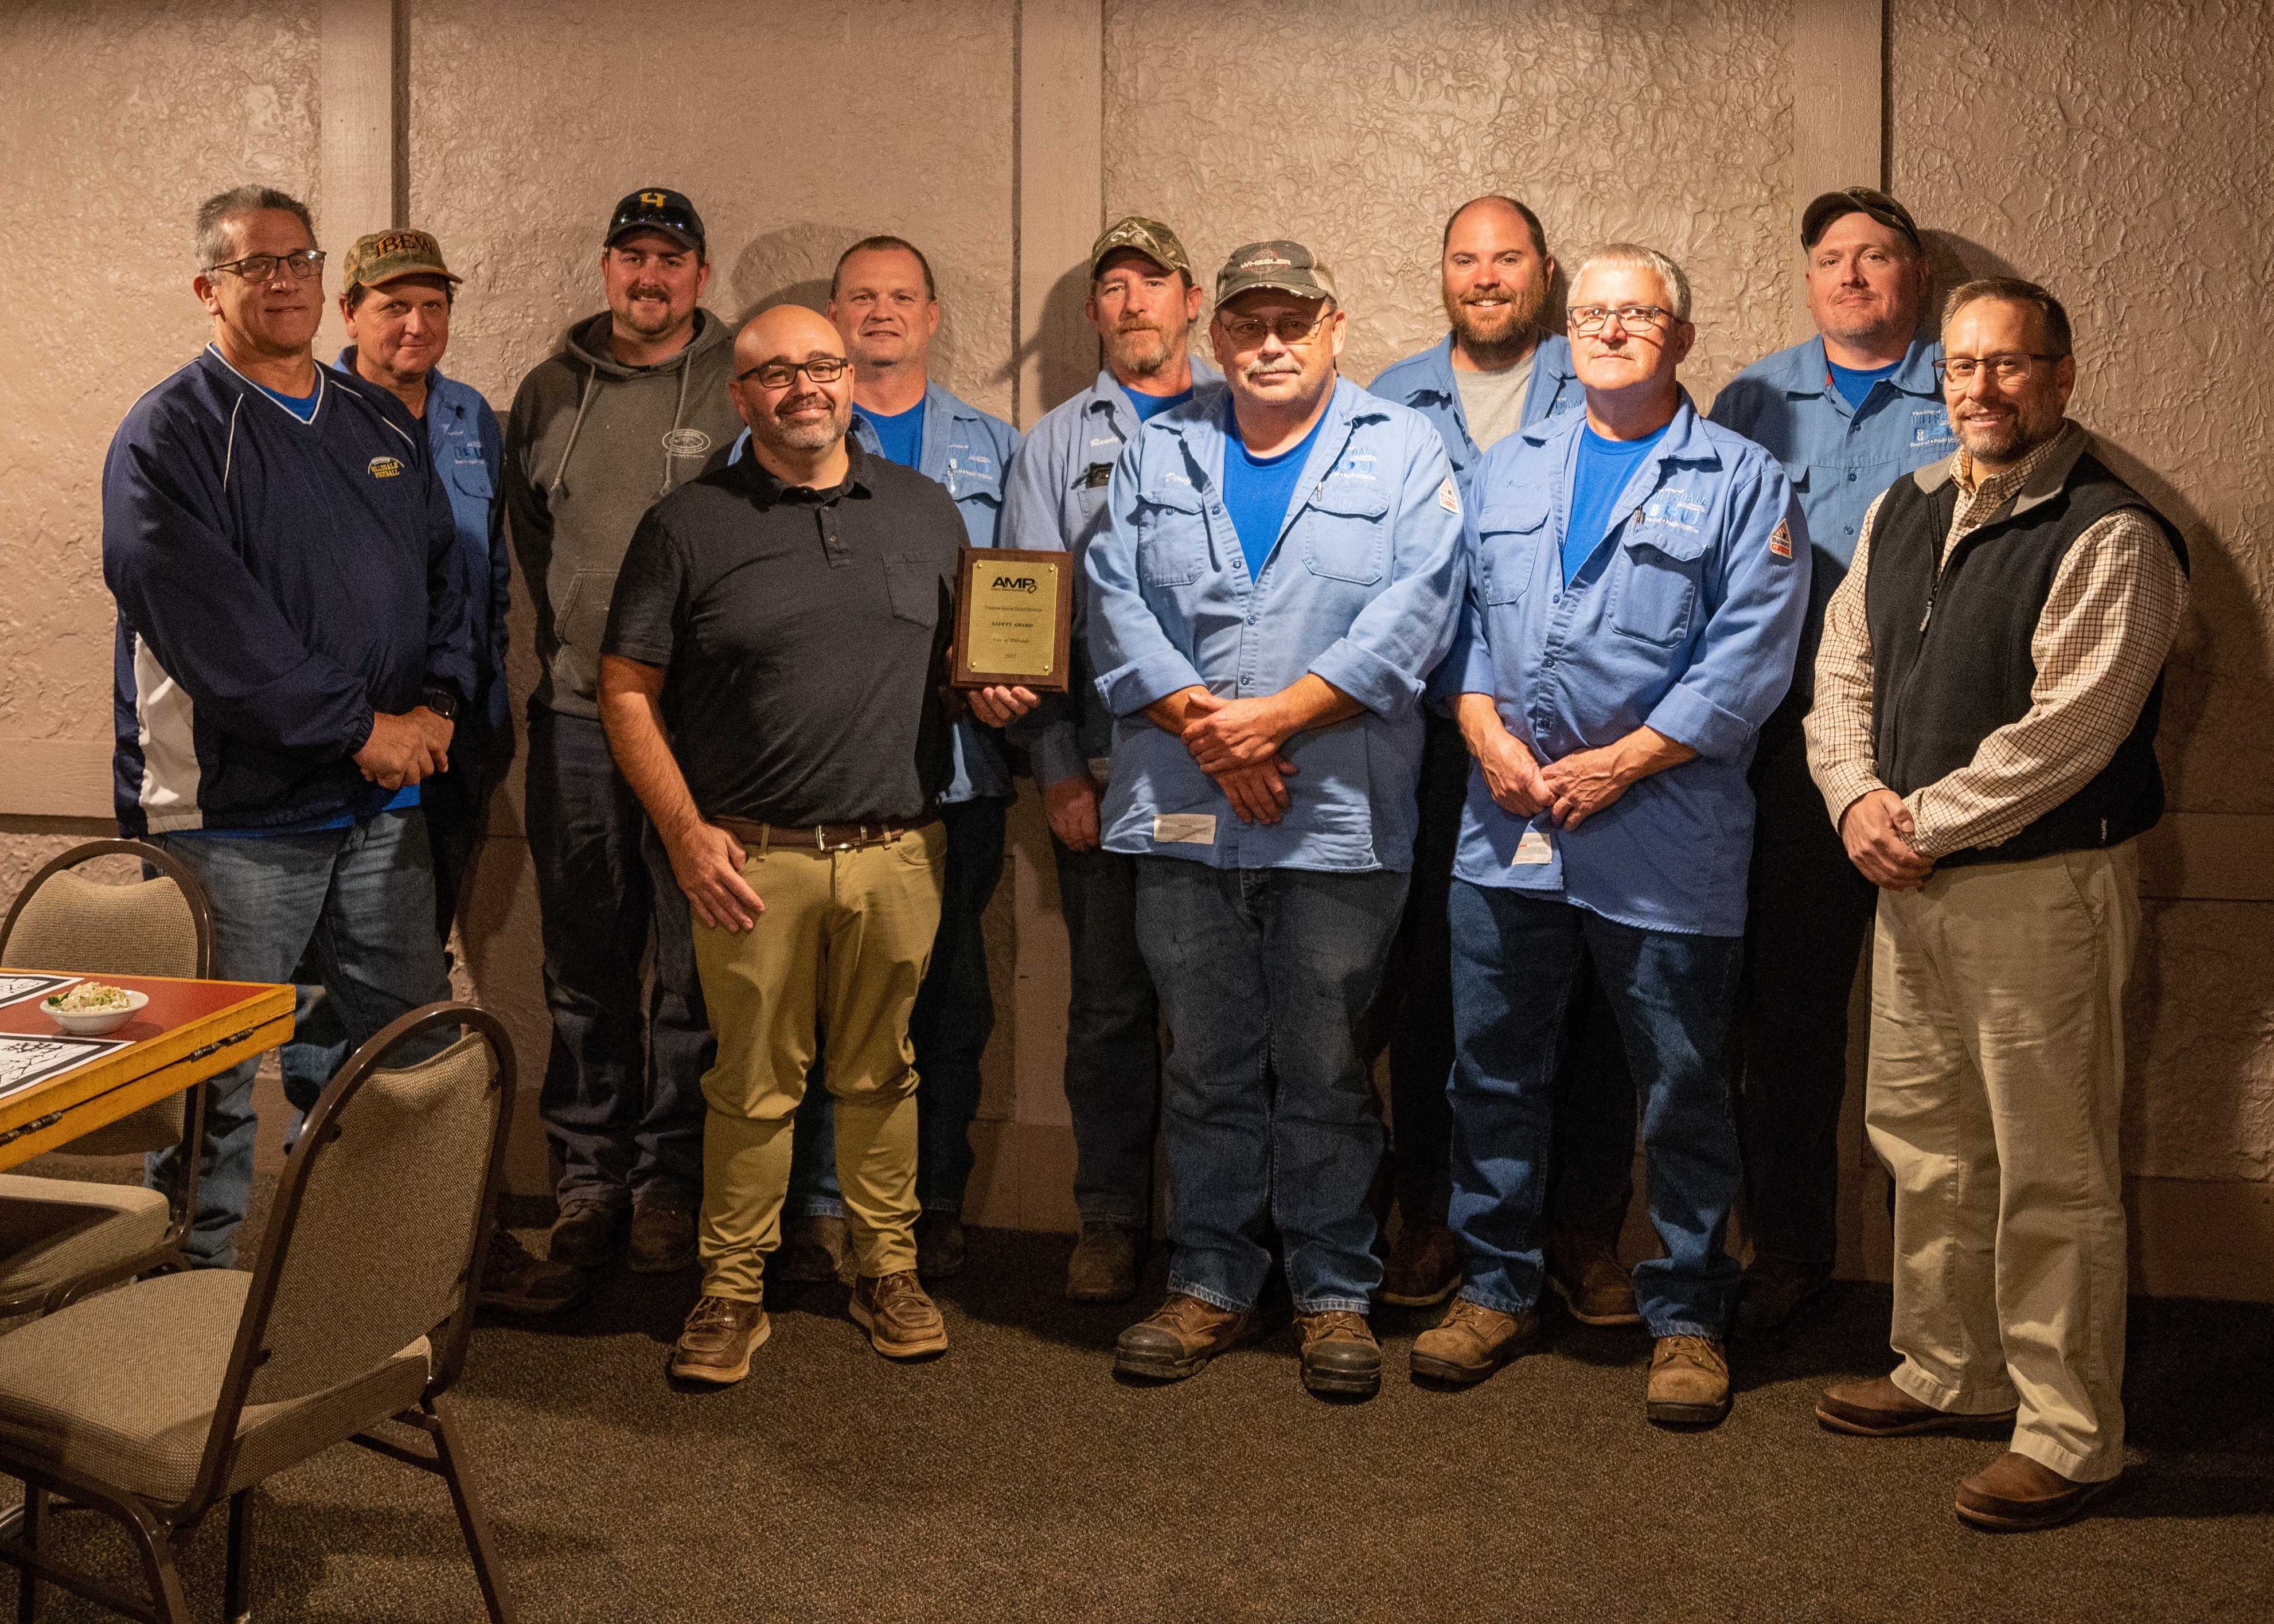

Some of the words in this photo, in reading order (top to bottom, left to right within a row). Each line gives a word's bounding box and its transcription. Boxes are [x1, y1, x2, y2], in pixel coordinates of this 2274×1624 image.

[376, 233, 432, 257] IBEW
[1240, 258, 1291, 269] WHEELER
[992, 577, 1035, 589] AMP
